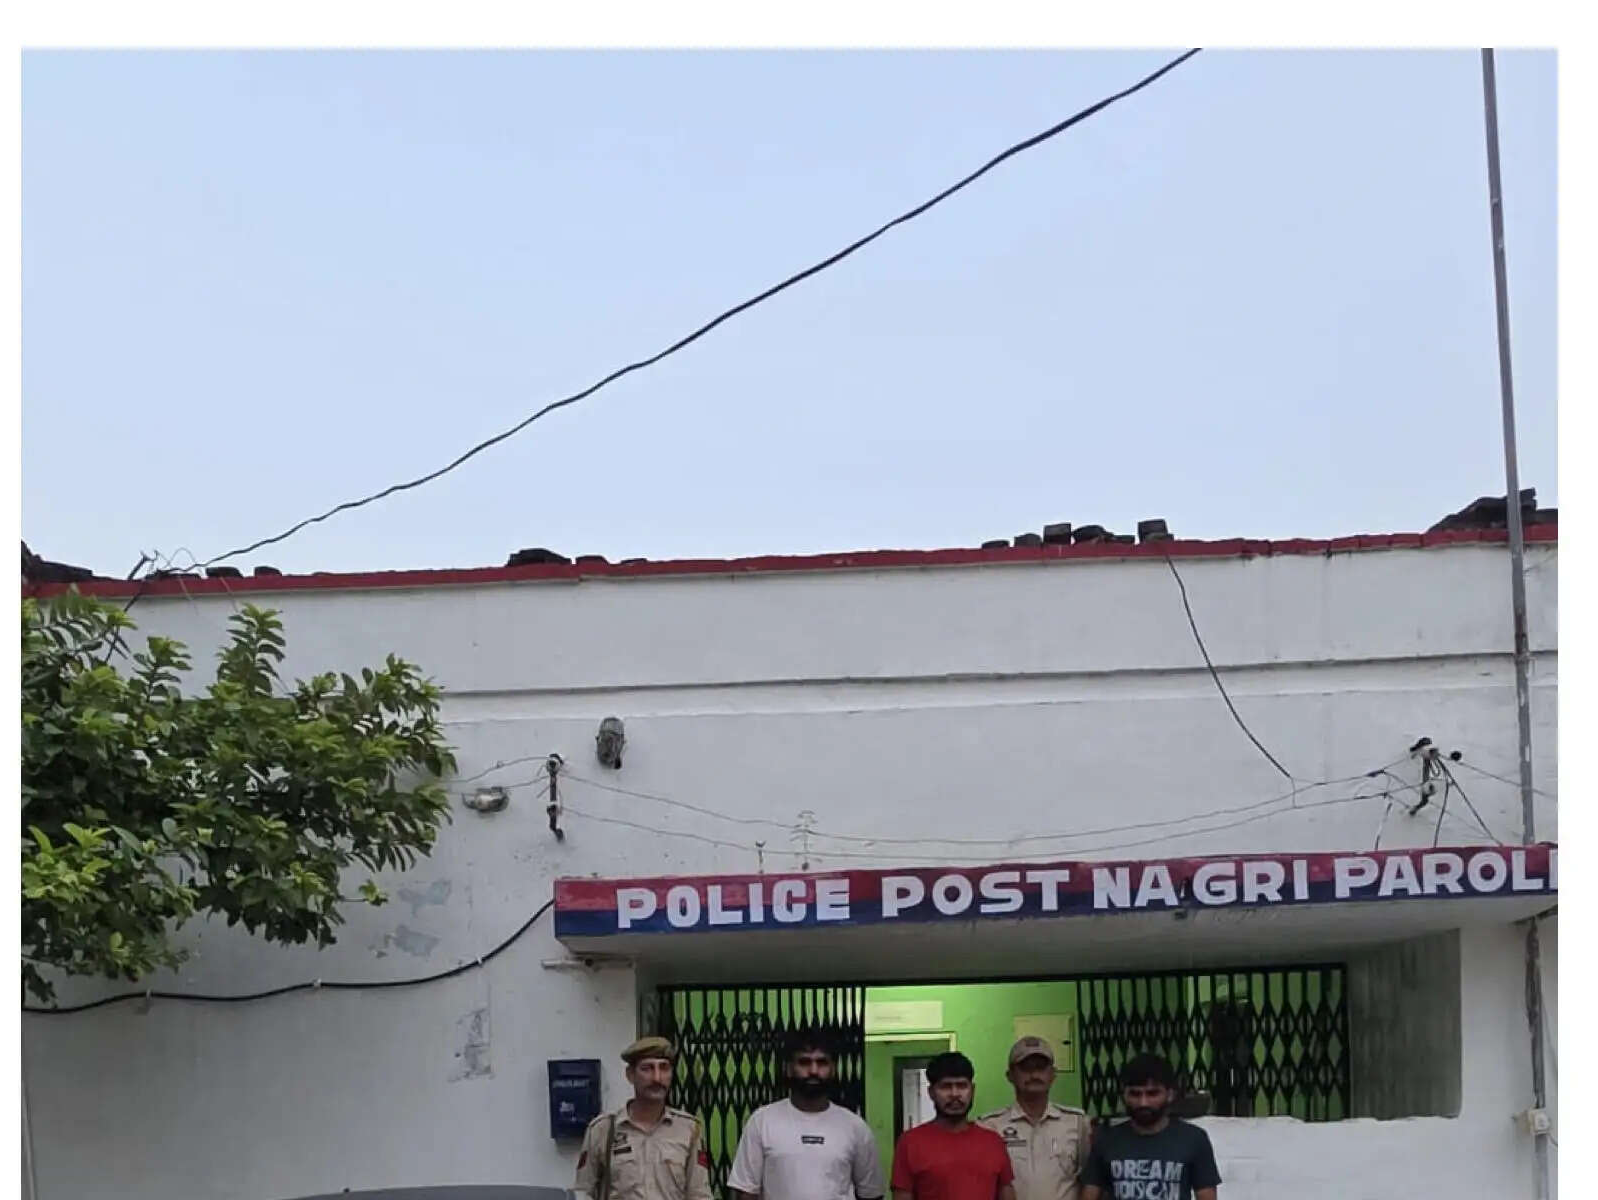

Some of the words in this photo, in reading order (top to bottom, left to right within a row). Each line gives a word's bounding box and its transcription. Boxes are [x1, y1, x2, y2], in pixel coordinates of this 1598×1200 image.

[616, 878, 850, 929] POLICE
[882, 869, 1070, 918] POST
[1110, 1159, 1185, 1181] DREAM
